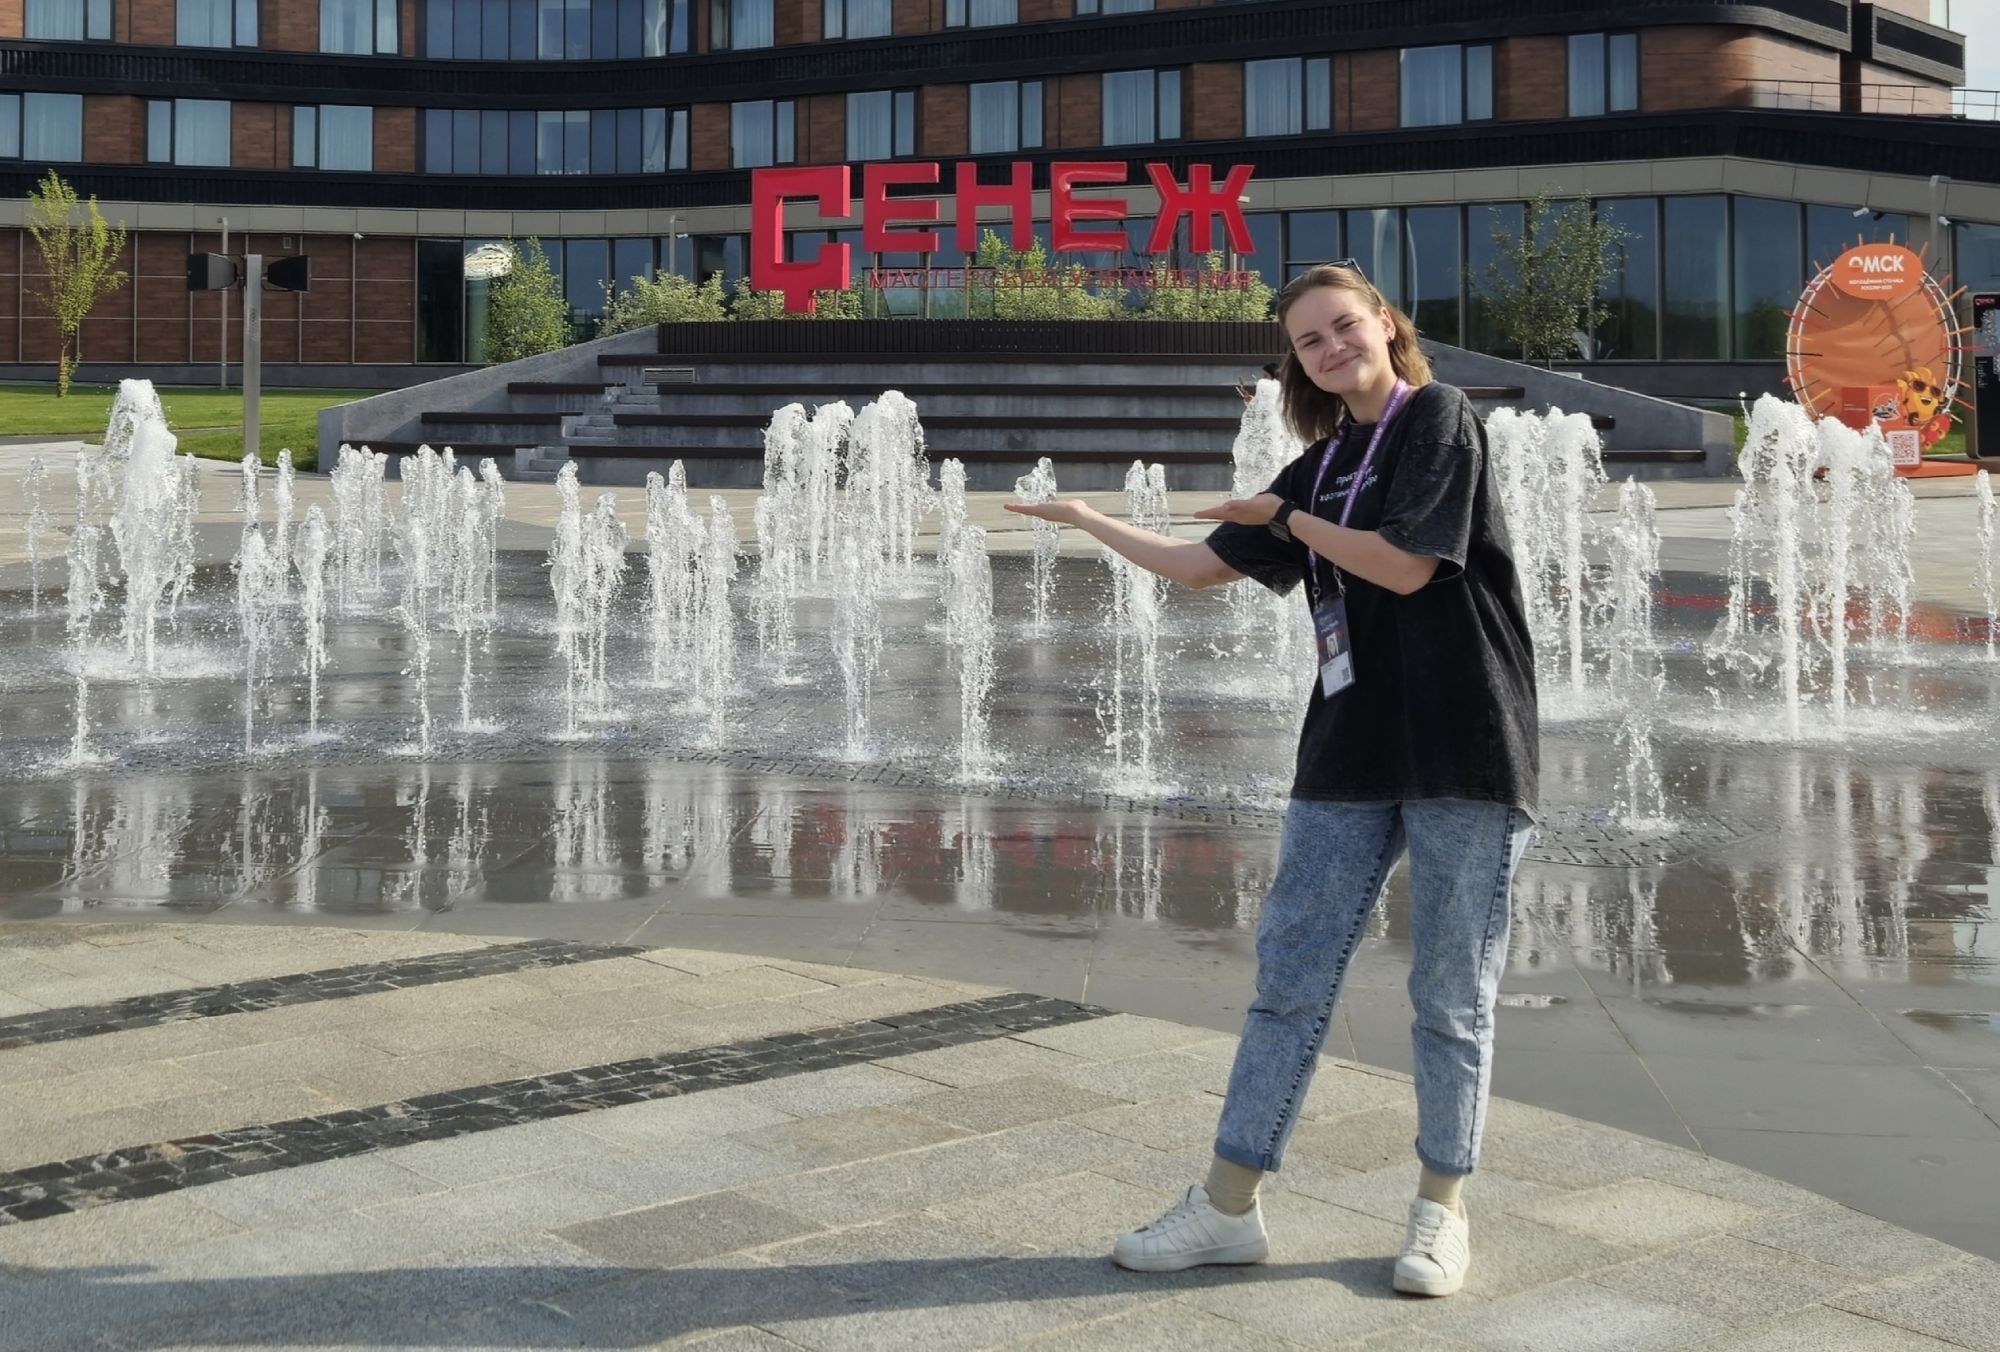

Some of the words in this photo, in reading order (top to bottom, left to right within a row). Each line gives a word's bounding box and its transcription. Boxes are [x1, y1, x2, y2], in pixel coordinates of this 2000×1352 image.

[751, 161, 1256, 313] СЕНЕЖ
[1849, 255, 1904, 272] ОМСК
[869, 268, 1057, 288] МАСТЕРСКАЯ
